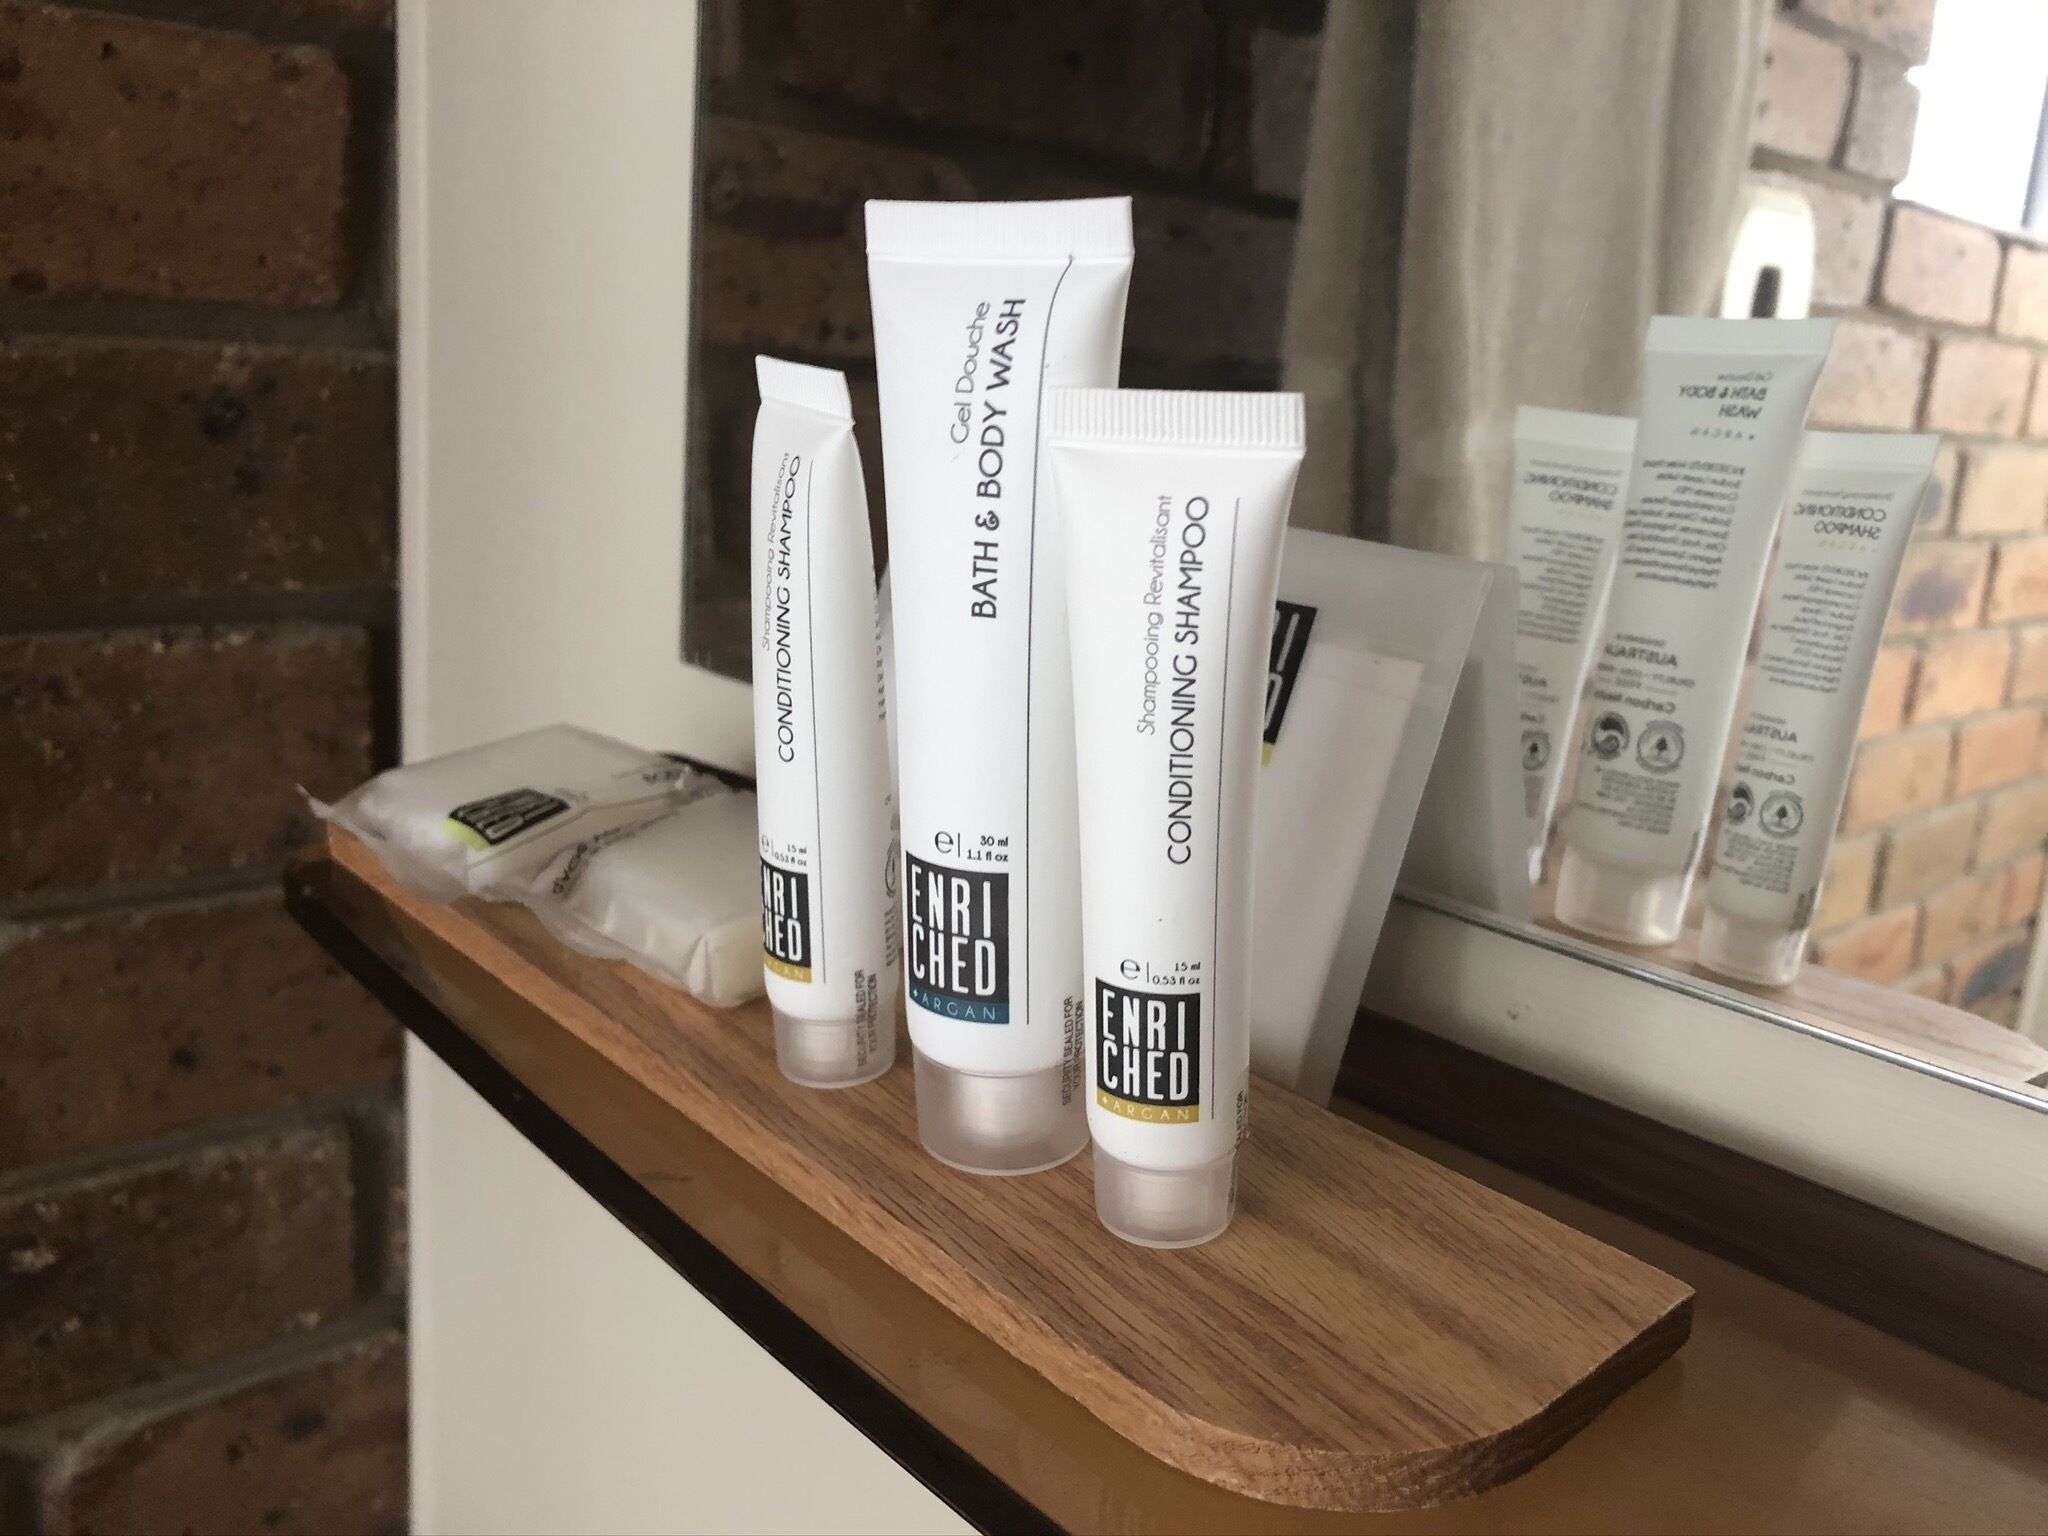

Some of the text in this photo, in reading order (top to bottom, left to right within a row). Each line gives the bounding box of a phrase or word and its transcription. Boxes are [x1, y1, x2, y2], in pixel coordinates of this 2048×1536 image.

[950, 301, 991, 444] Gel Douche
[971, 298, 1026, 619] BATH & BODY WASH
[775, 455, 800, 763] CONDITIONING SHAMPOO
[1136, 495, 1173, 736] Shampooing Revitalisant
[1167, 496, 1209, 865] CONDITIONING SHAMPOO
[967, 849, 1009, 862] 1.1 fl oz
[980, 835, 1009, 847] 30 ml
[761, 862, 799, 920] NRI
[911, 863, 992, 938] ENRI
[763, 913, 803, 962] HED
[911, 921, 997, 997] CHED
[1175, 962, 1201, 972] 15 ml
[921, 992, 996, 1021] ARGAN
[1152, 975, 1201, 986] 0.53 fl oz
[1062, 995, 1074, 1106] SECURITY SEALED FOR
[1102, 988, 1186, 1051] ENRI
[1102, 1039, 1189, 1101] CHED
[1112, 1099, 1190, 1121] ARGAN
